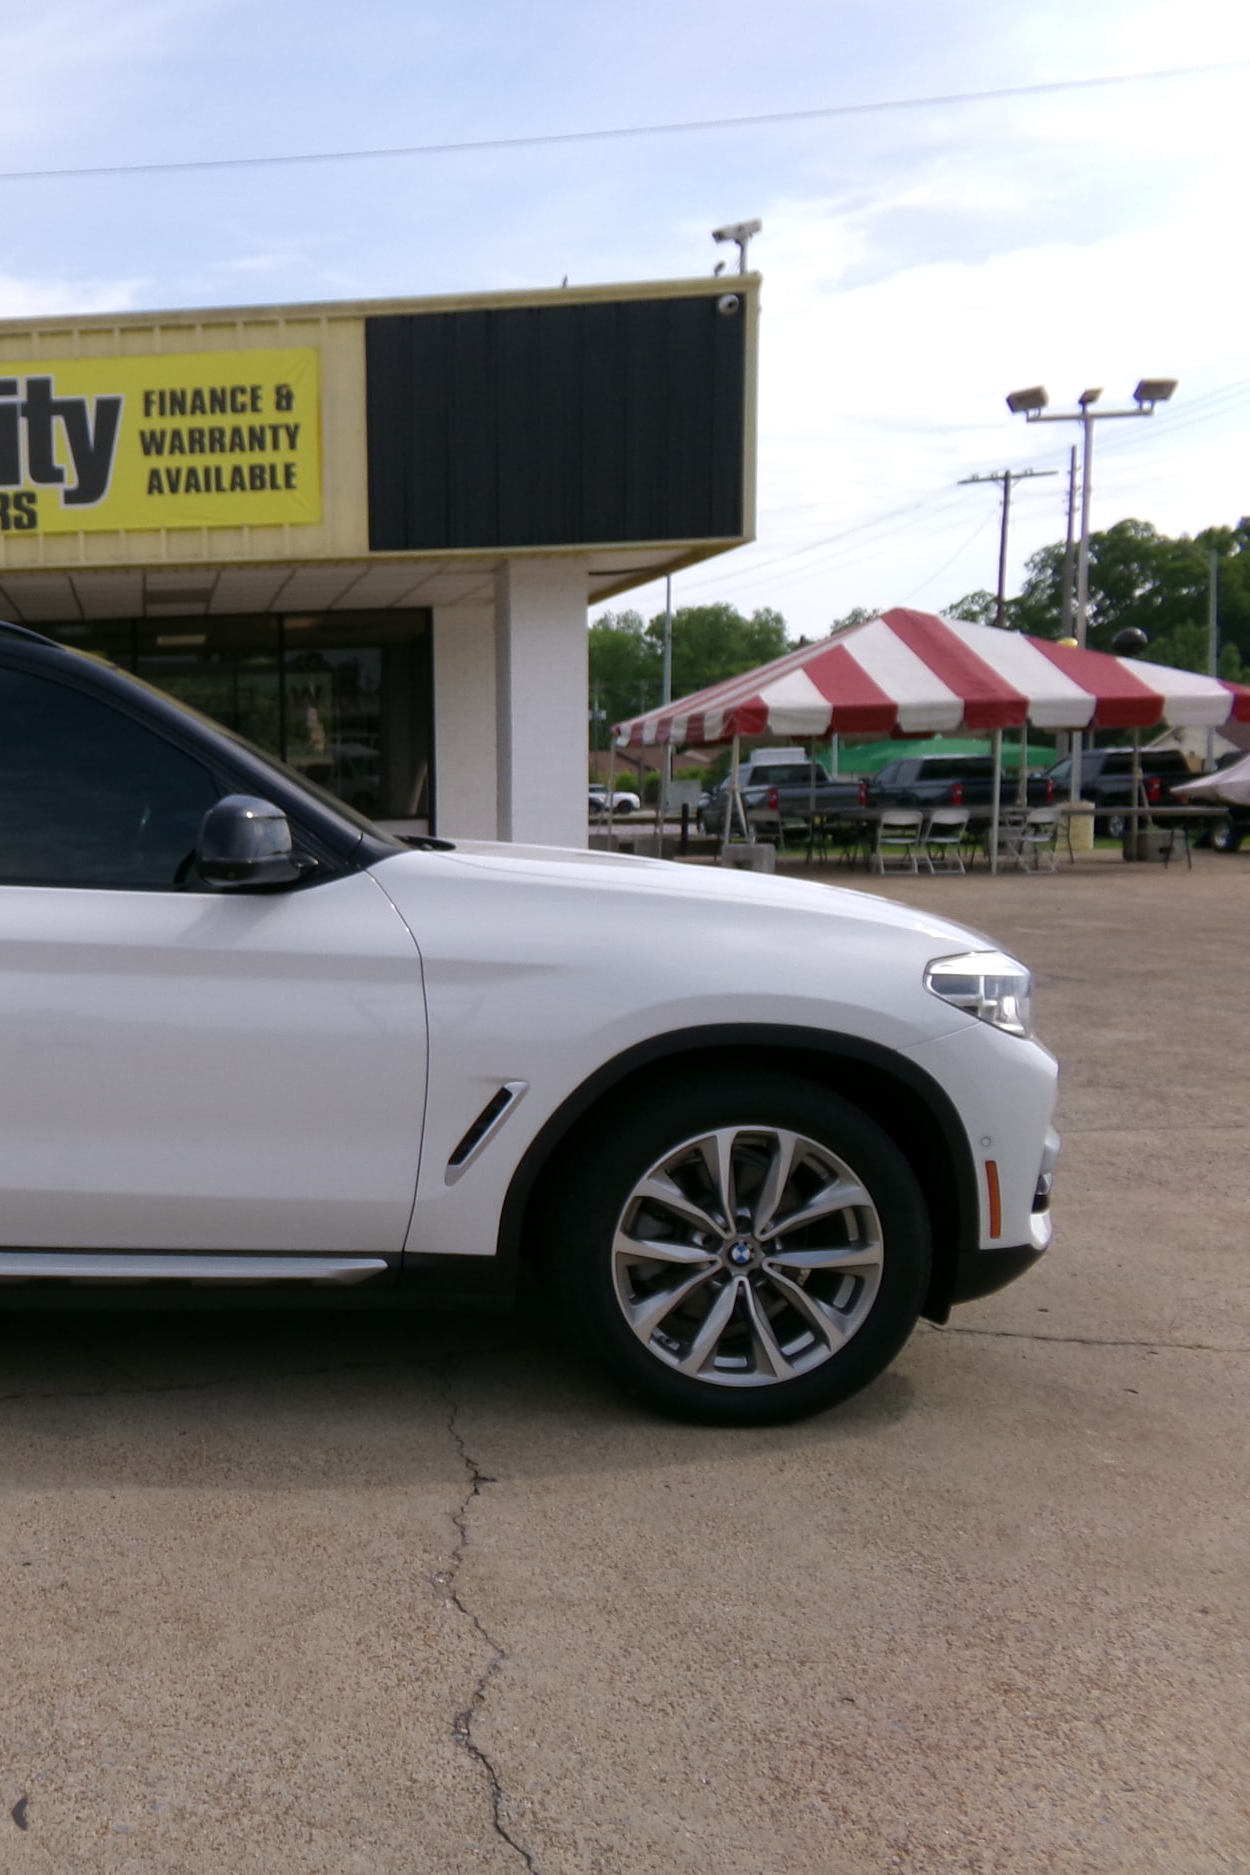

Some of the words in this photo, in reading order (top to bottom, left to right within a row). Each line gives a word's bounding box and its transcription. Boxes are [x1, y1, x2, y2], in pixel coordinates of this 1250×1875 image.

[143, 384, 263, 418] FINANCE
[274, 383, 295, 412] &
[139, 422, 301, 457] WARRANTY
[146, 462, 298, 495] AVAILABLE
